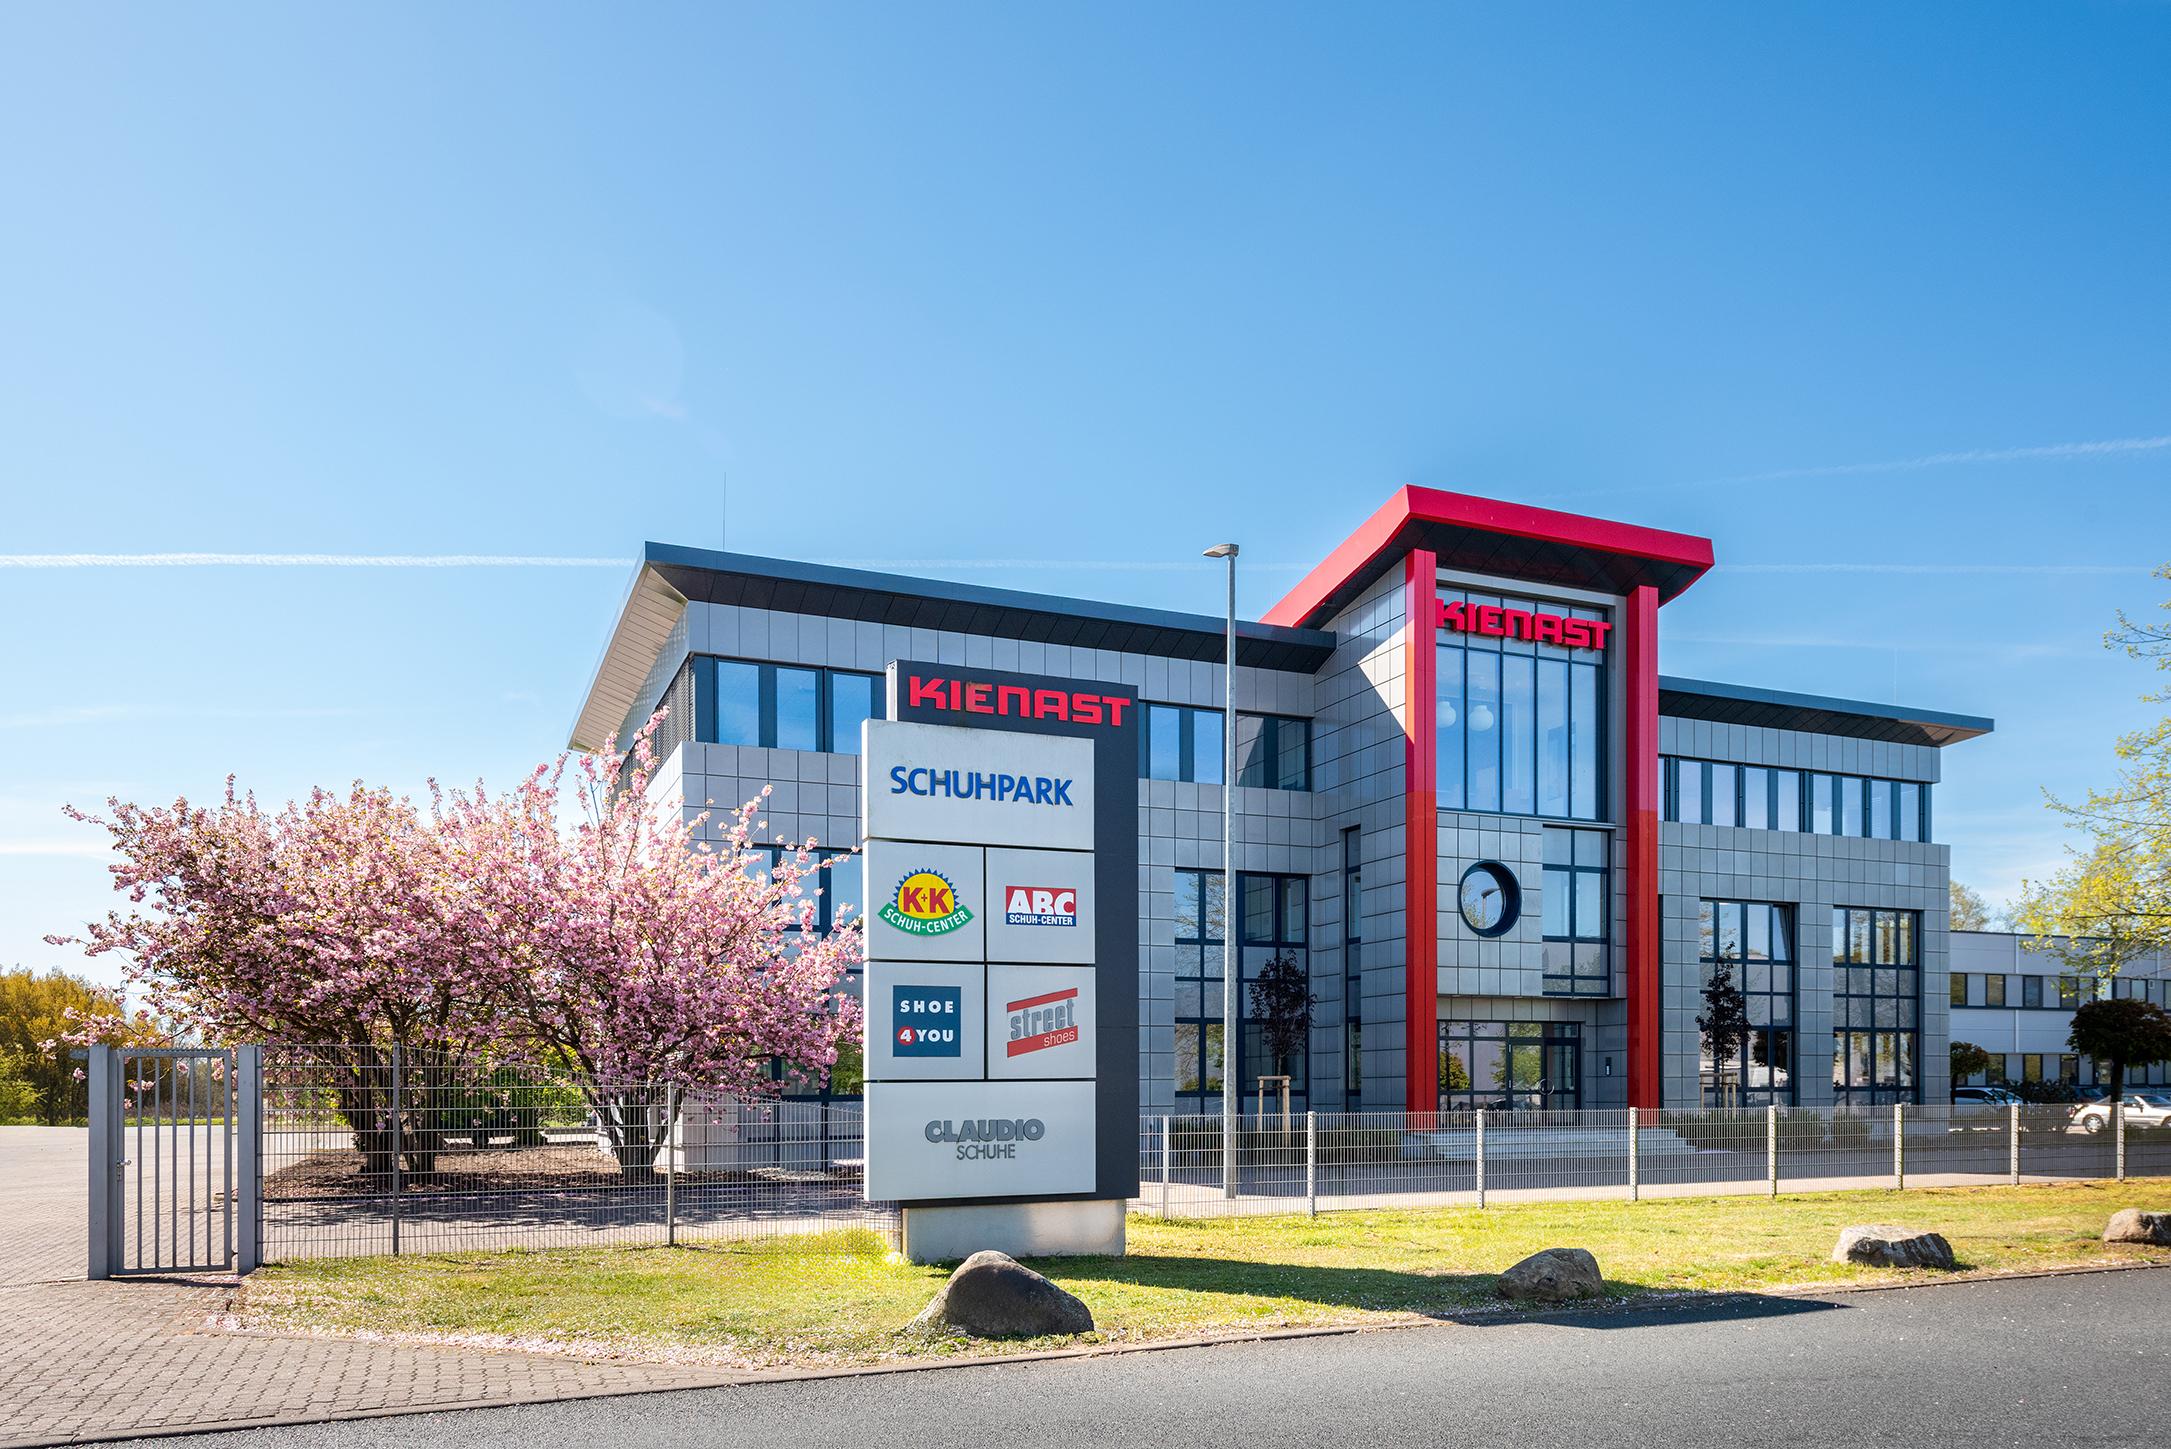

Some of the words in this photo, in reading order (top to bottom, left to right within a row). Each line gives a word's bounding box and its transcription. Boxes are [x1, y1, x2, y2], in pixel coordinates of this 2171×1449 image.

[1436, 598, 1612, 649] KIENAST
[909, 676, 1131, 726] KIENAST
[890, 766, 1073, 806] SCHUHPARK
[1007, 889, 1074, 916] ABC
[883, 909, 969, 933] SCHUH-CENTER
[1009, 913, 1073, 926] SCHUH-CENTER
[900, 1000, 954, 1014] SHOE
[1010, 999, 1075, 1040] street
[1043, 1030, 1075, 1048] shoes
[924, 1118, 1046, 1144] CLAUDIO
[956, 1143, 1016, 1161] SCHUHE
